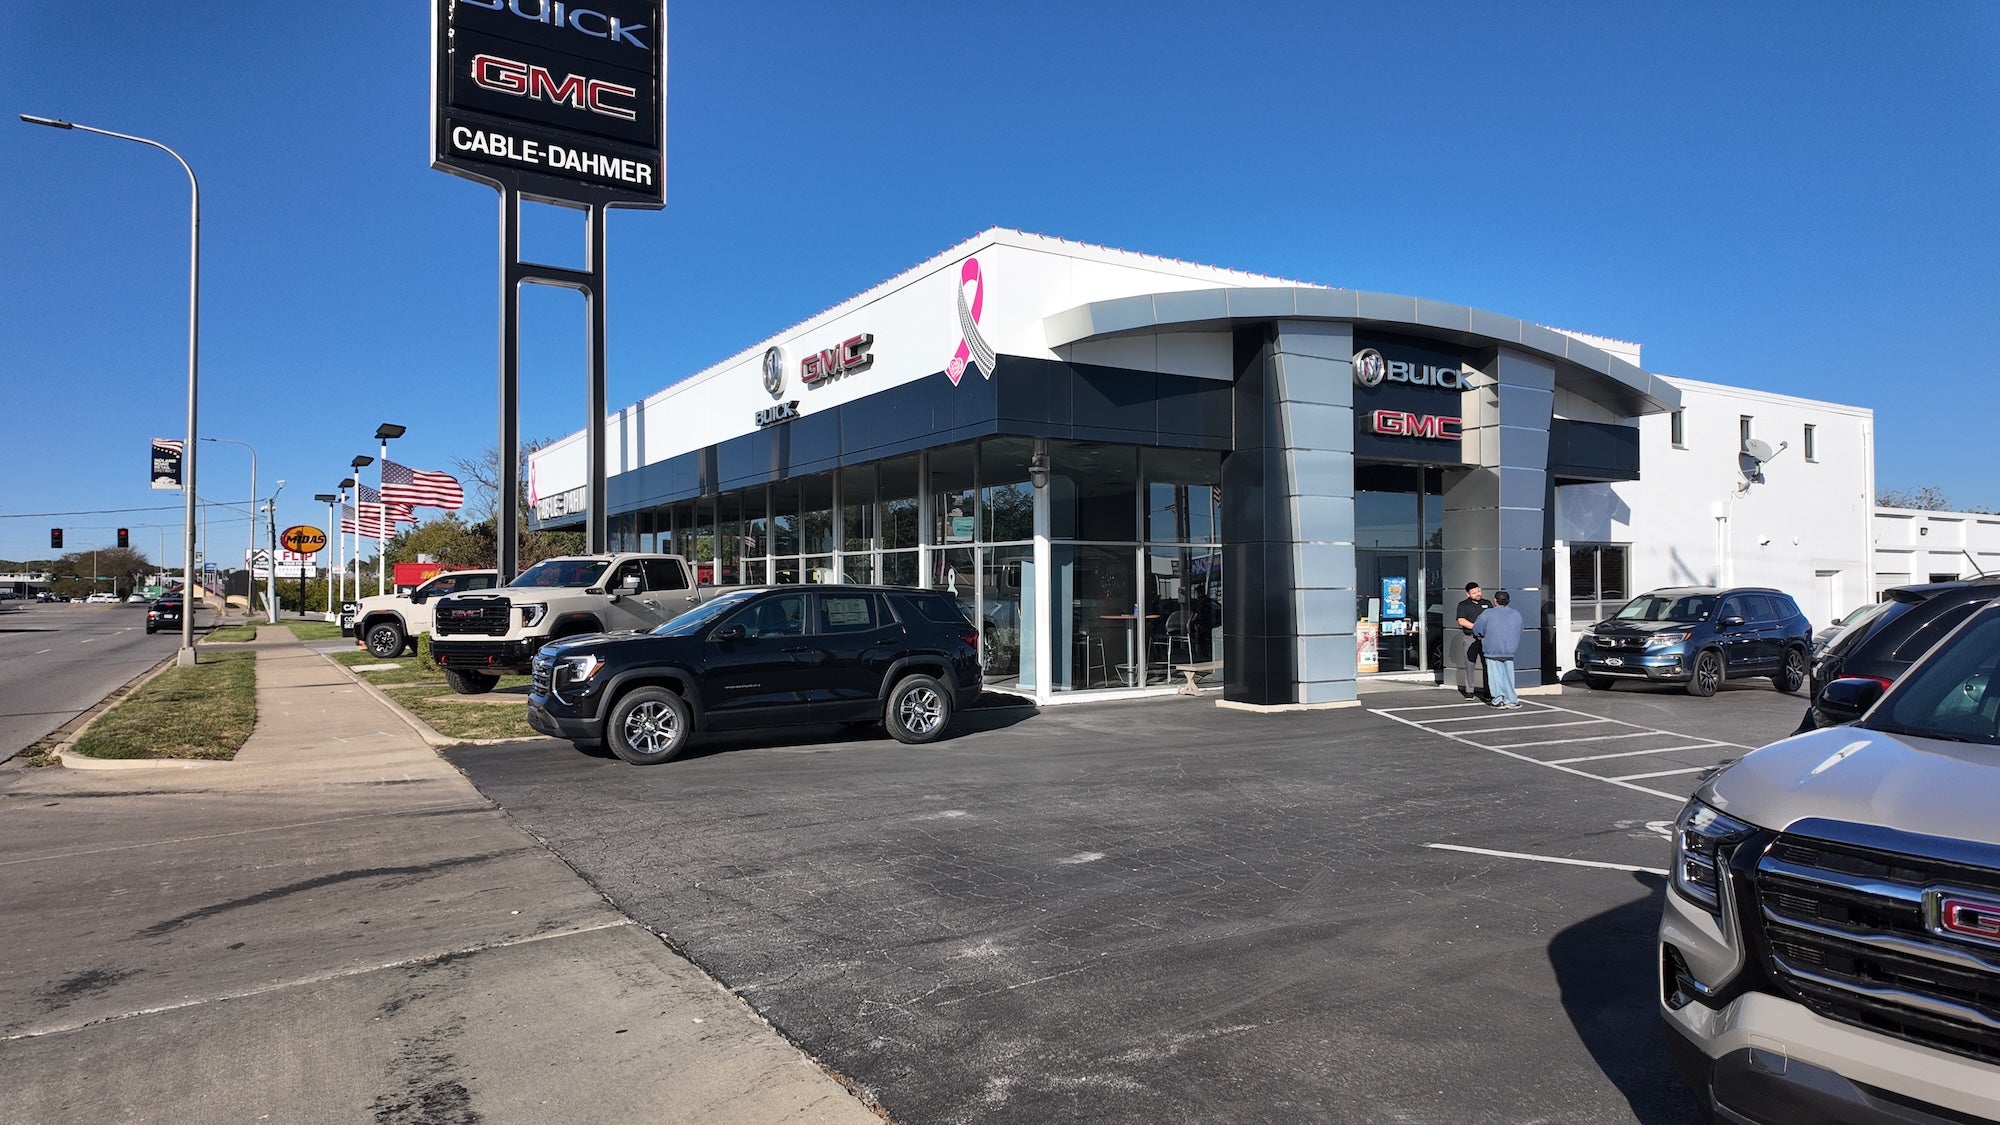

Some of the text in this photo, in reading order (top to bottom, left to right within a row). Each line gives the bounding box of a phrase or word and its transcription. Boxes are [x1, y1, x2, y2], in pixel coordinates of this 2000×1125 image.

[460, 0, 650, 50] UICK
[472, 54, 636, 121] GMC
[453, 126, 652, 185] CABLE-DAHMER
[801, 333, 873, 384] GMC
[1387, 360, 1474, 390] BUICK
[755, 400, 800, 426] BUICK
[1373, 409, 1462, 440] GMC
[286, 535, 324, 544] MIDAS
[283, 551, 313, 561] FLIP
